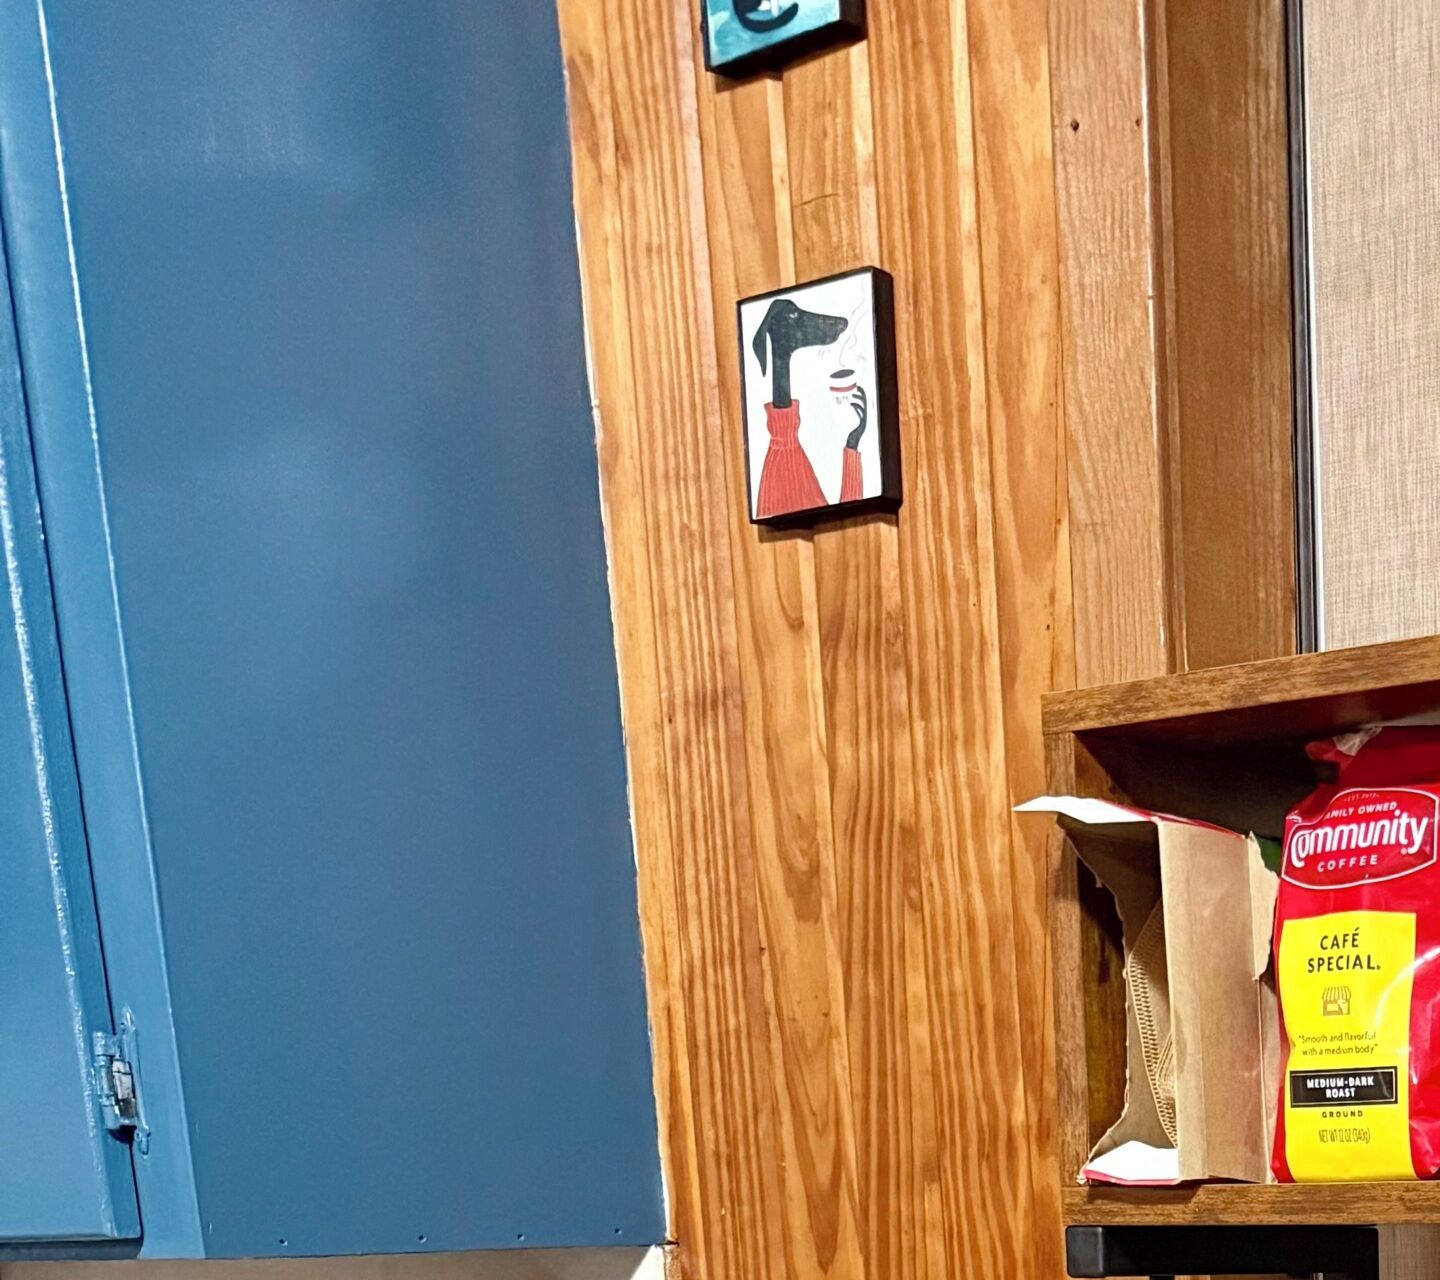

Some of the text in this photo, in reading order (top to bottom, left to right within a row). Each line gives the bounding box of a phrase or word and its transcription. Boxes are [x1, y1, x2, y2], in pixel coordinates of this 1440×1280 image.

[1326, 801, 1398, 820] AMILY OWNED
[1290, 809, 1429, 867] Community
[1317, 854, 1379, 872] COFFEE
[1320, 927, 1360, 950] CAFÉ
[1329, 1033, 1343, 1042] and
[1302, 1047, 1317, 1056] with
[1325, 1046, 1354, 1055] medium
[1306, 1075, 1375, 1089] MEDIUM-DARK
[1325, 1088, 1356, 1098] ROAST
[1322, 1110, 1363, 1119] GROUND
